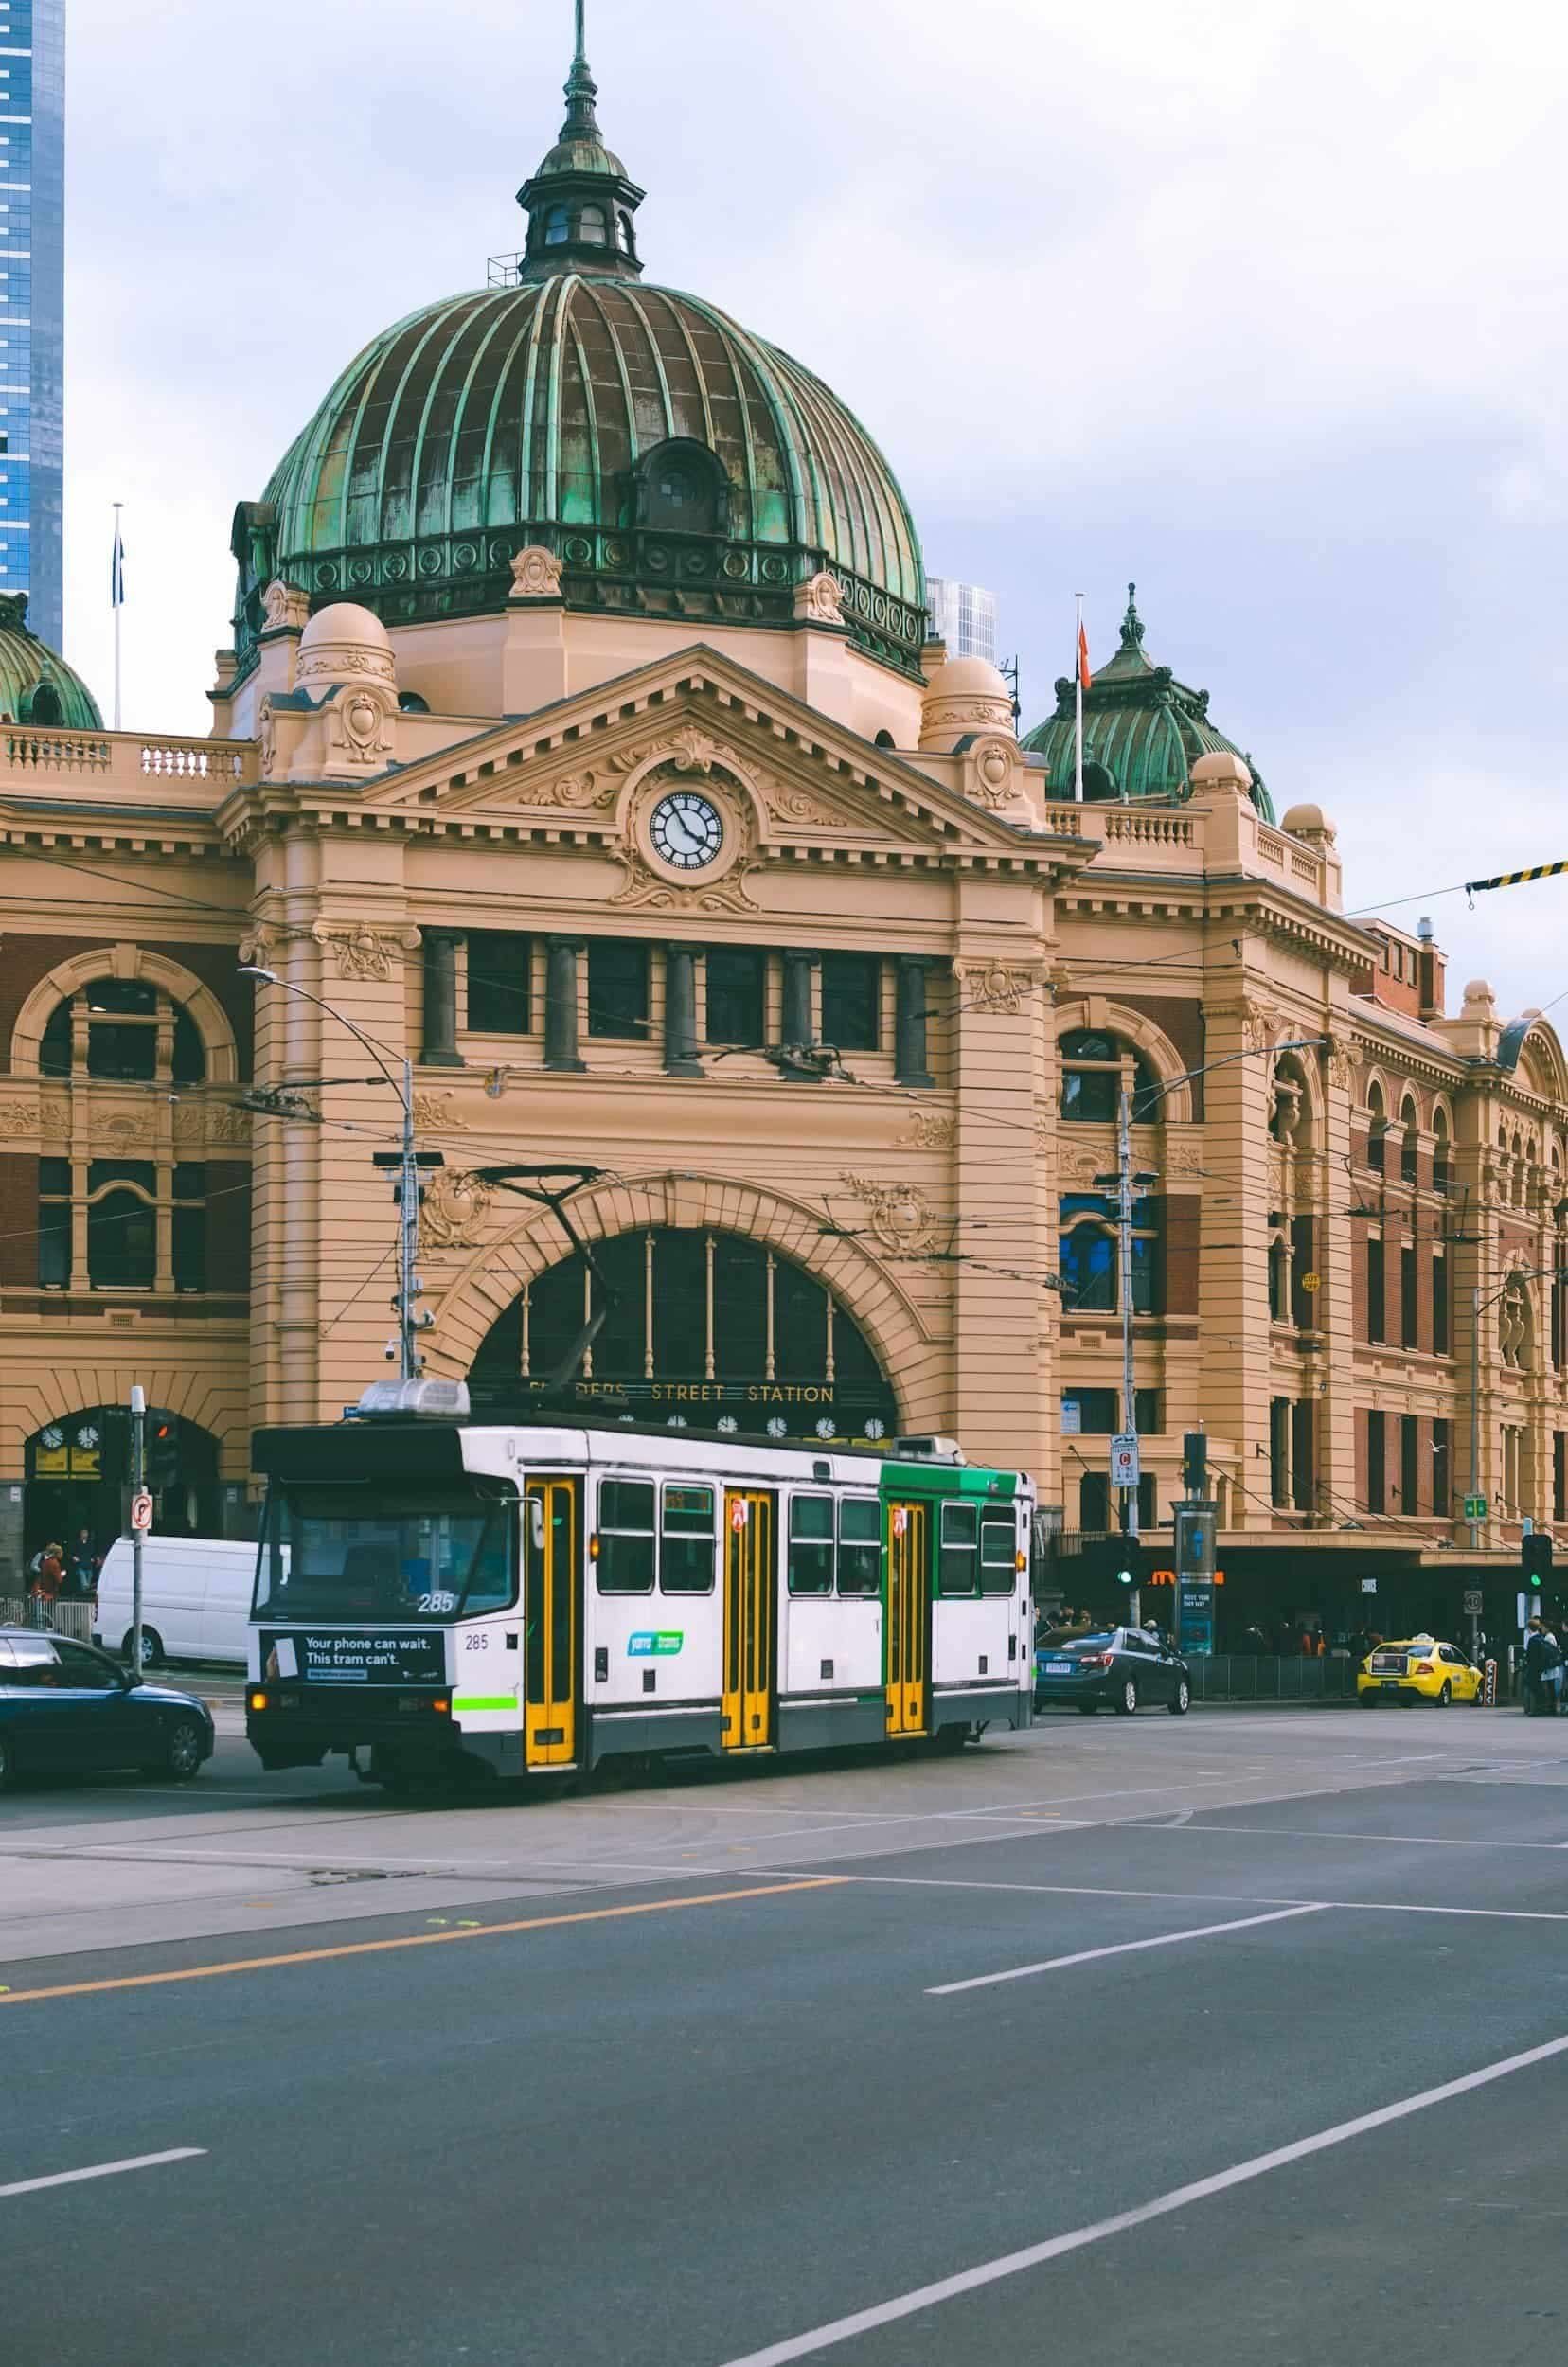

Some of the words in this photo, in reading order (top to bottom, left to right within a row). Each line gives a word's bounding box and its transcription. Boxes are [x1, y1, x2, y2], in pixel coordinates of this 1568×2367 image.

[651, 1384, 726, 1401] STREET
[748, 1385, 834, 1402] STATION
[418, 1593, 454, 1612] 285
[306, 1637, 331, 1649] Your
[334, 1637, 371, 1651] phone
[374, 1640, 396, 1649] can
[399, 1637, 431, 1649] wait.
[466, 1634, 489, 1650] 285
[307, 1652, 330, 1664] This
[333, 1653, 364, 1664] tram
[365, 1653, 400, 1664] can't.
